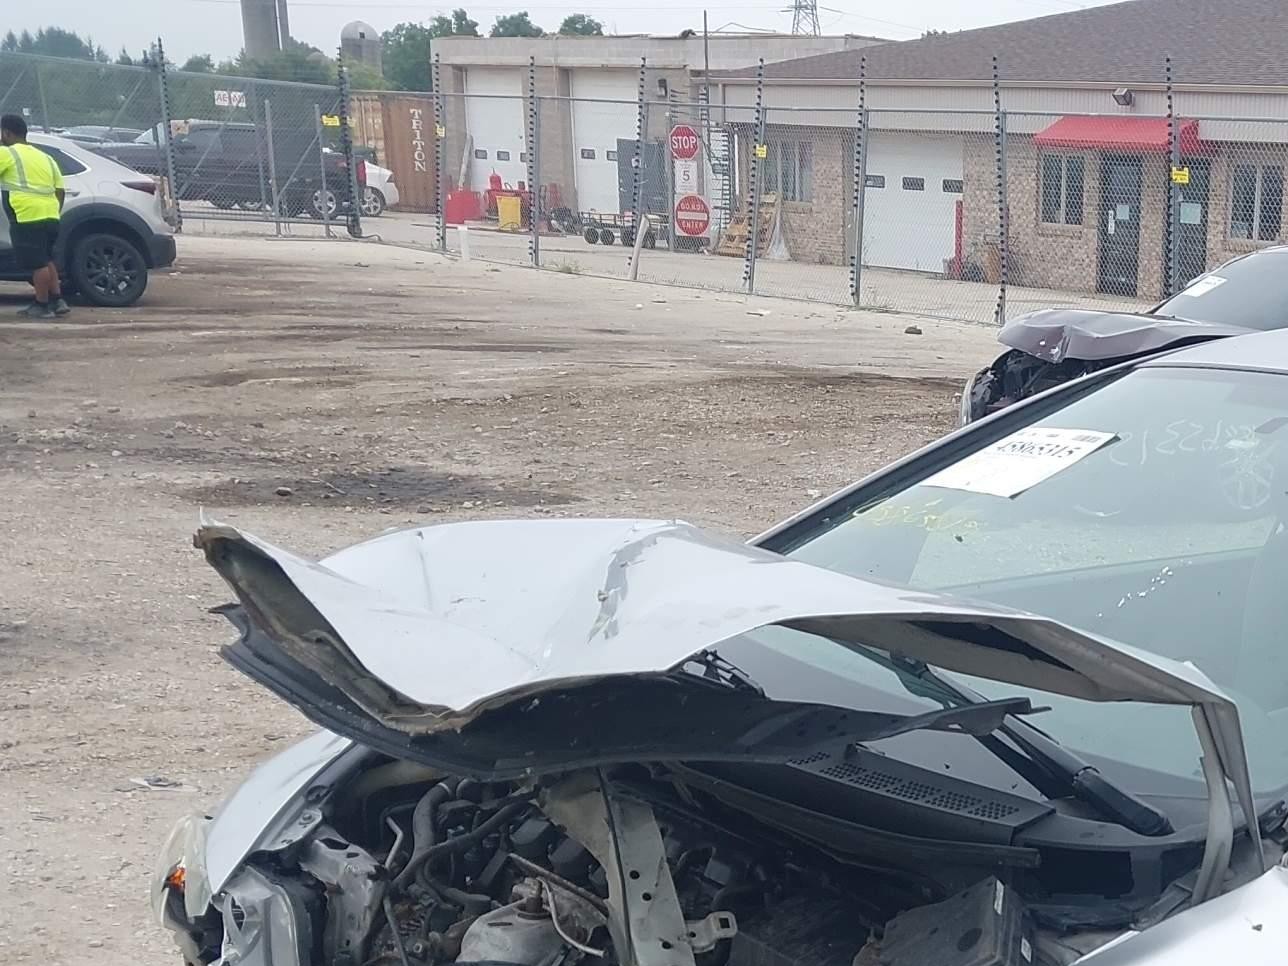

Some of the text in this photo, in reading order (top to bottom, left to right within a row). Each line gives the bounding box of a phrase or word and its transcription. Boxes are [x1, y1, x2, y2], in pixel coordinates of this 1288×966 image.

[410, 109, 426, 171] TRITON
[672, 136, 697, 148] STOP
[683, 170, 691, 181] 5
